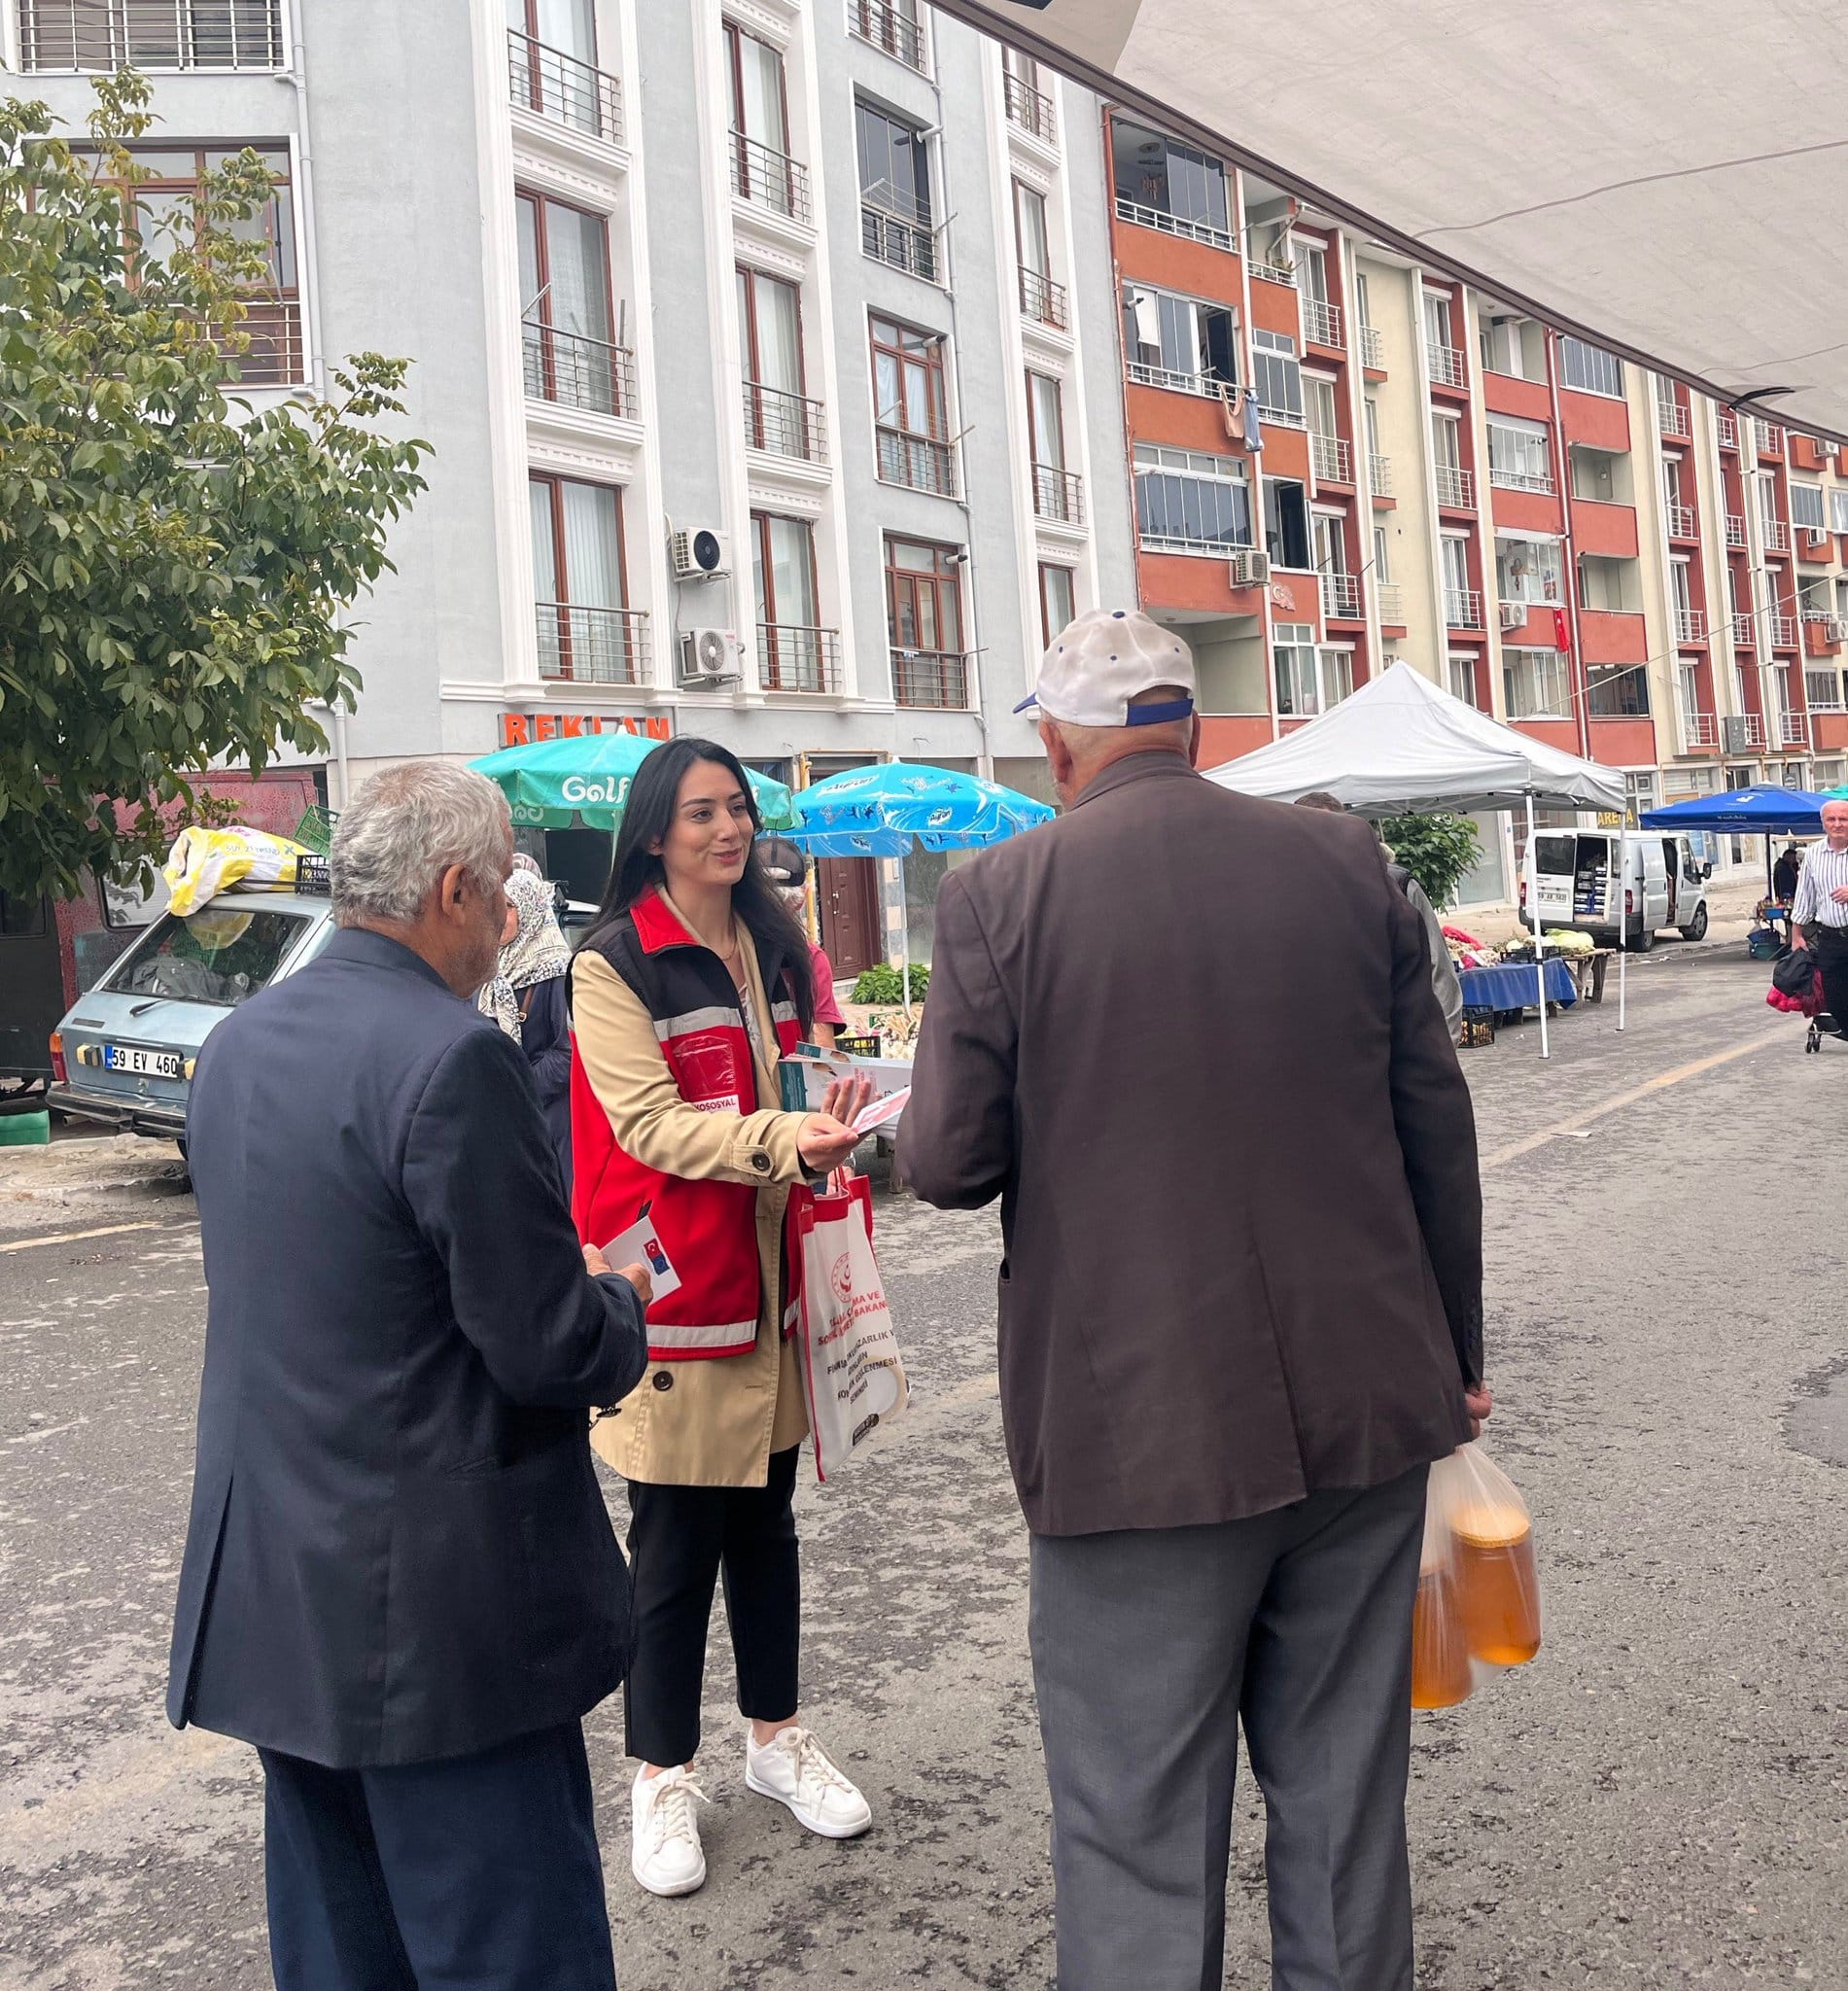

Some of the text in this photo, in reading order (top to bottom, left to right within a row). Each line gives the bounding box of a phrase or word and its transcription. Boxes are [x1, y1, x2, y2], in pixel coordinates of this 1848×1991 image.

[561, 776, 630, 803] Golf
[1597, 809, 1633, 825] AREA
[112, 1049, 178, 1075] 59 EV 460
[854, 1300, 888, 1318] BAKAN
